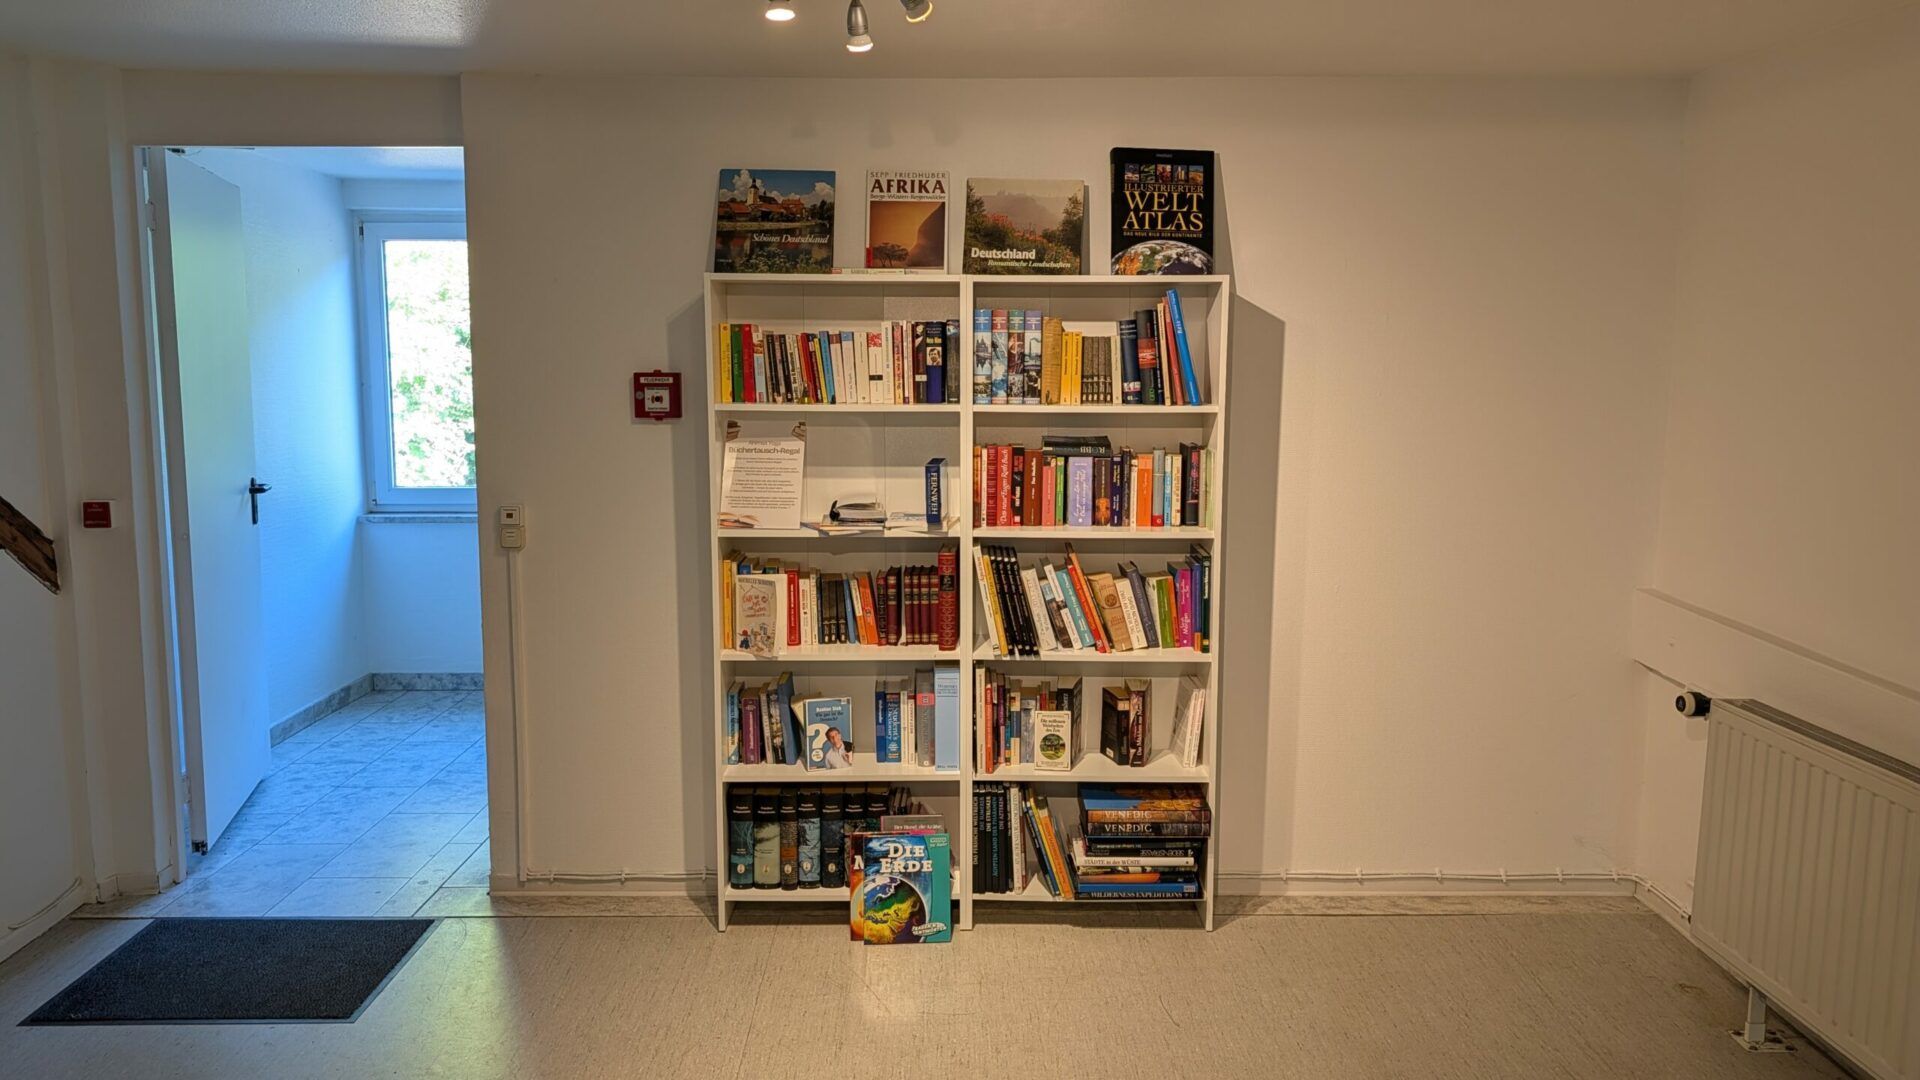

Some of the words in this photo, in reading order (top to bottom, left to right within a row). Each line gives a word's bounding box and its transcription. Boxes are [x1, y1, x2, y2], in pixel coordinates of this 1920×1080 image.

[870, 179, 946, 194] AFRIKA
[1124, 184, 1204, 193] ILLUSTRIERTER
[1123, 191, 1204, 212] WELT
[1122, 211, 1204, 231] ATLAS
[752, 233, 781, 243] Schönes
[782, 233, 830, 244] Deutschland
[971, 247, 1036, 260] Deutschland
[987, 259, 1028, 268] Romantische
[1029, 260, 1071, 269] Landschaften
[1001, 449, 1009, 464] Buch
[930, 472, 940, 515] FERNWEH
[999, 510, 1007, 523] Das
[1104, 810, 1153, 819] VENEDIG
[1104, 823, 1153, 833] VENEDIG
[888, 842, 925, 858] DIE
[880, 858, 933, 873] ERDE
